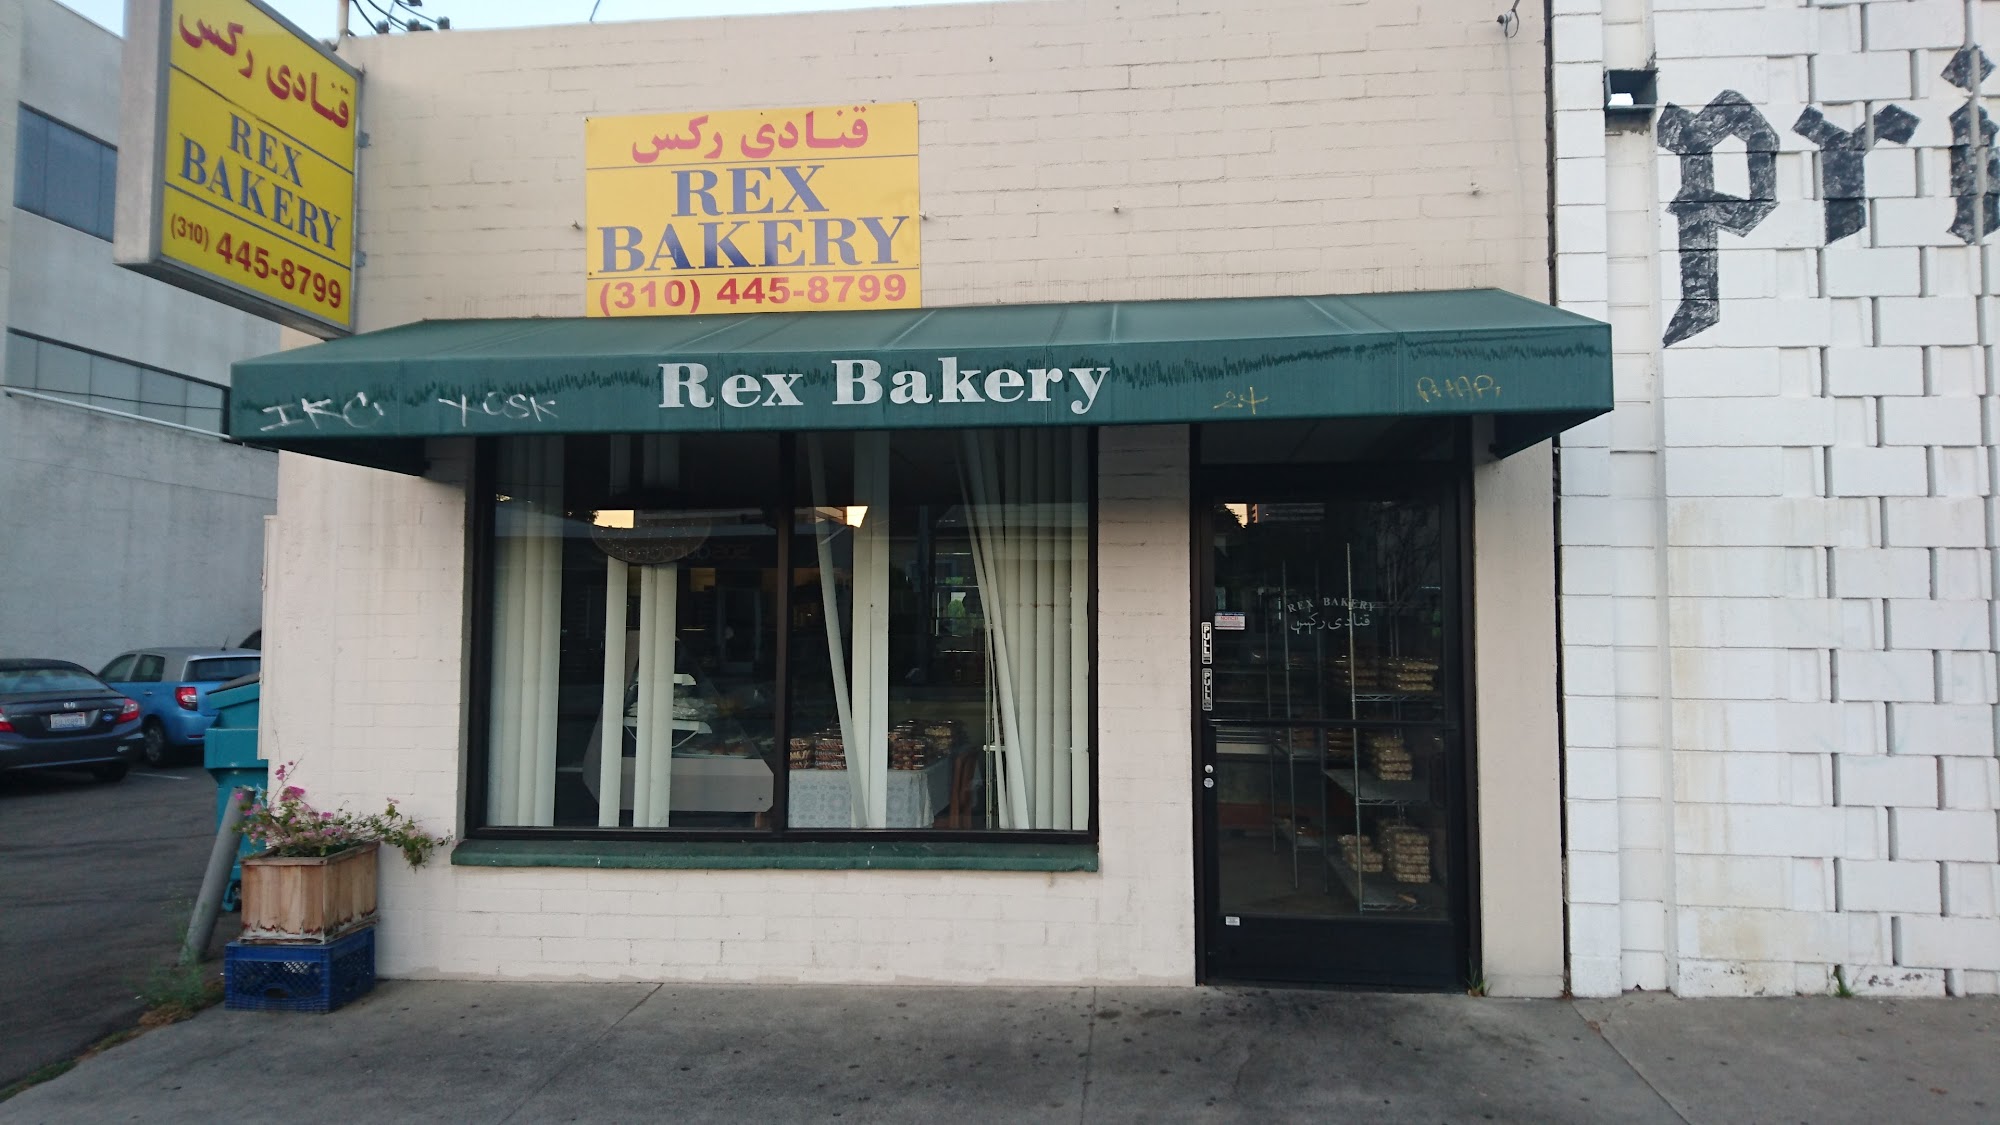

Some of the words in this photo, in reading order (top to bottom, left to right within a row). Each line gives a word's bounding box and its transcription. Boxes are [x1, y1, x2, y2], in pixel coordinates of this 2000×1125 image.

[227, 111, 303, 188] REX
[178, 133, 342, 251] BAKERY
[671, 165, 829, 217] REX
[170, 213, 210, 252] (310)
[215, 232, 342, 309] 445-8799
[597, 216, 910, 273] BAKERY
[600, 279, 701, 316] (310)
[717, 274, 907, 305] 445-8799
[658, 362, 804, 408] Rex
[831, 356, 1111, 415] Bakery
[1287, 600, 1314, 613] REX
[1323, 597, 1375, 611] BAKERY
